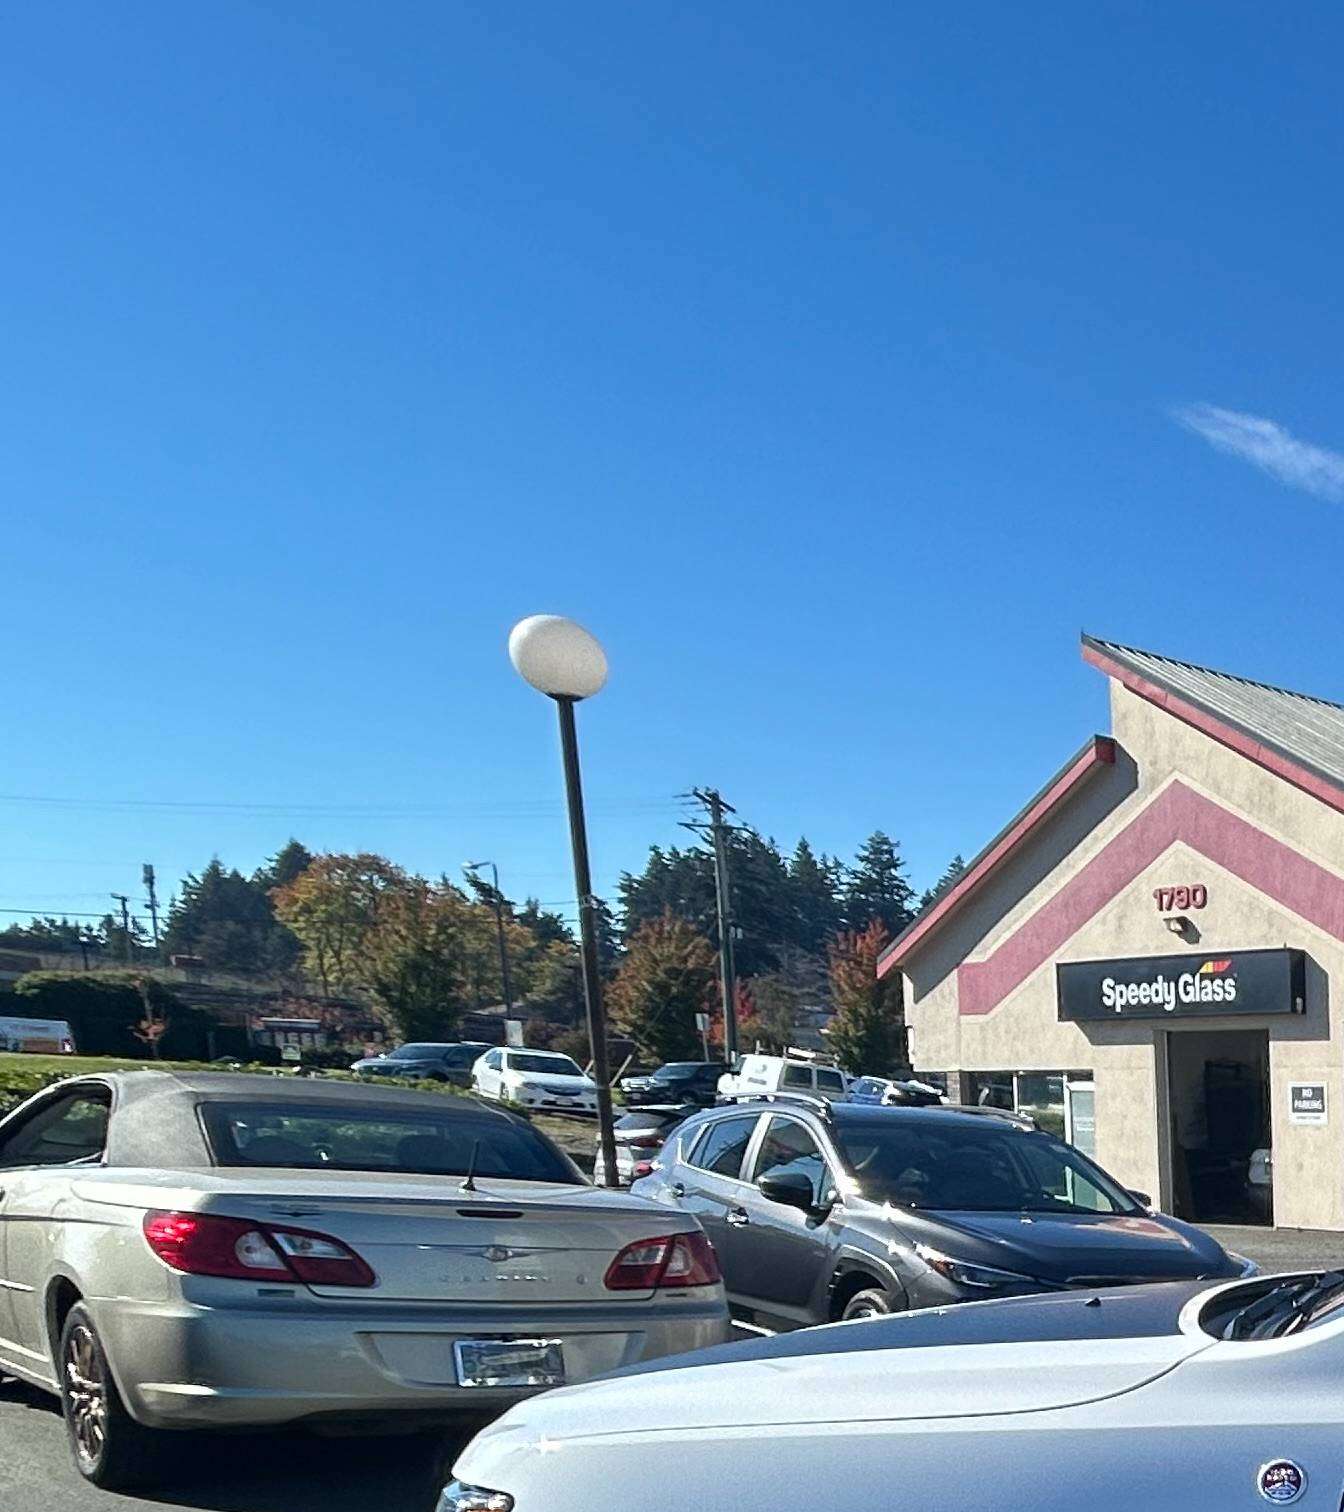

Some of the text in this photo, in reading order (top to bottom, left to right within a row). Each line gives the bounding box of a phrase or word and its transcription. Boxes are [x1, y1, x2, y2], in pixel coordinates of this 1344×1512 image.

[1153, 884, 1208, 912] 1790
[1101, 972, 1236, 1013] Speedy Glass
